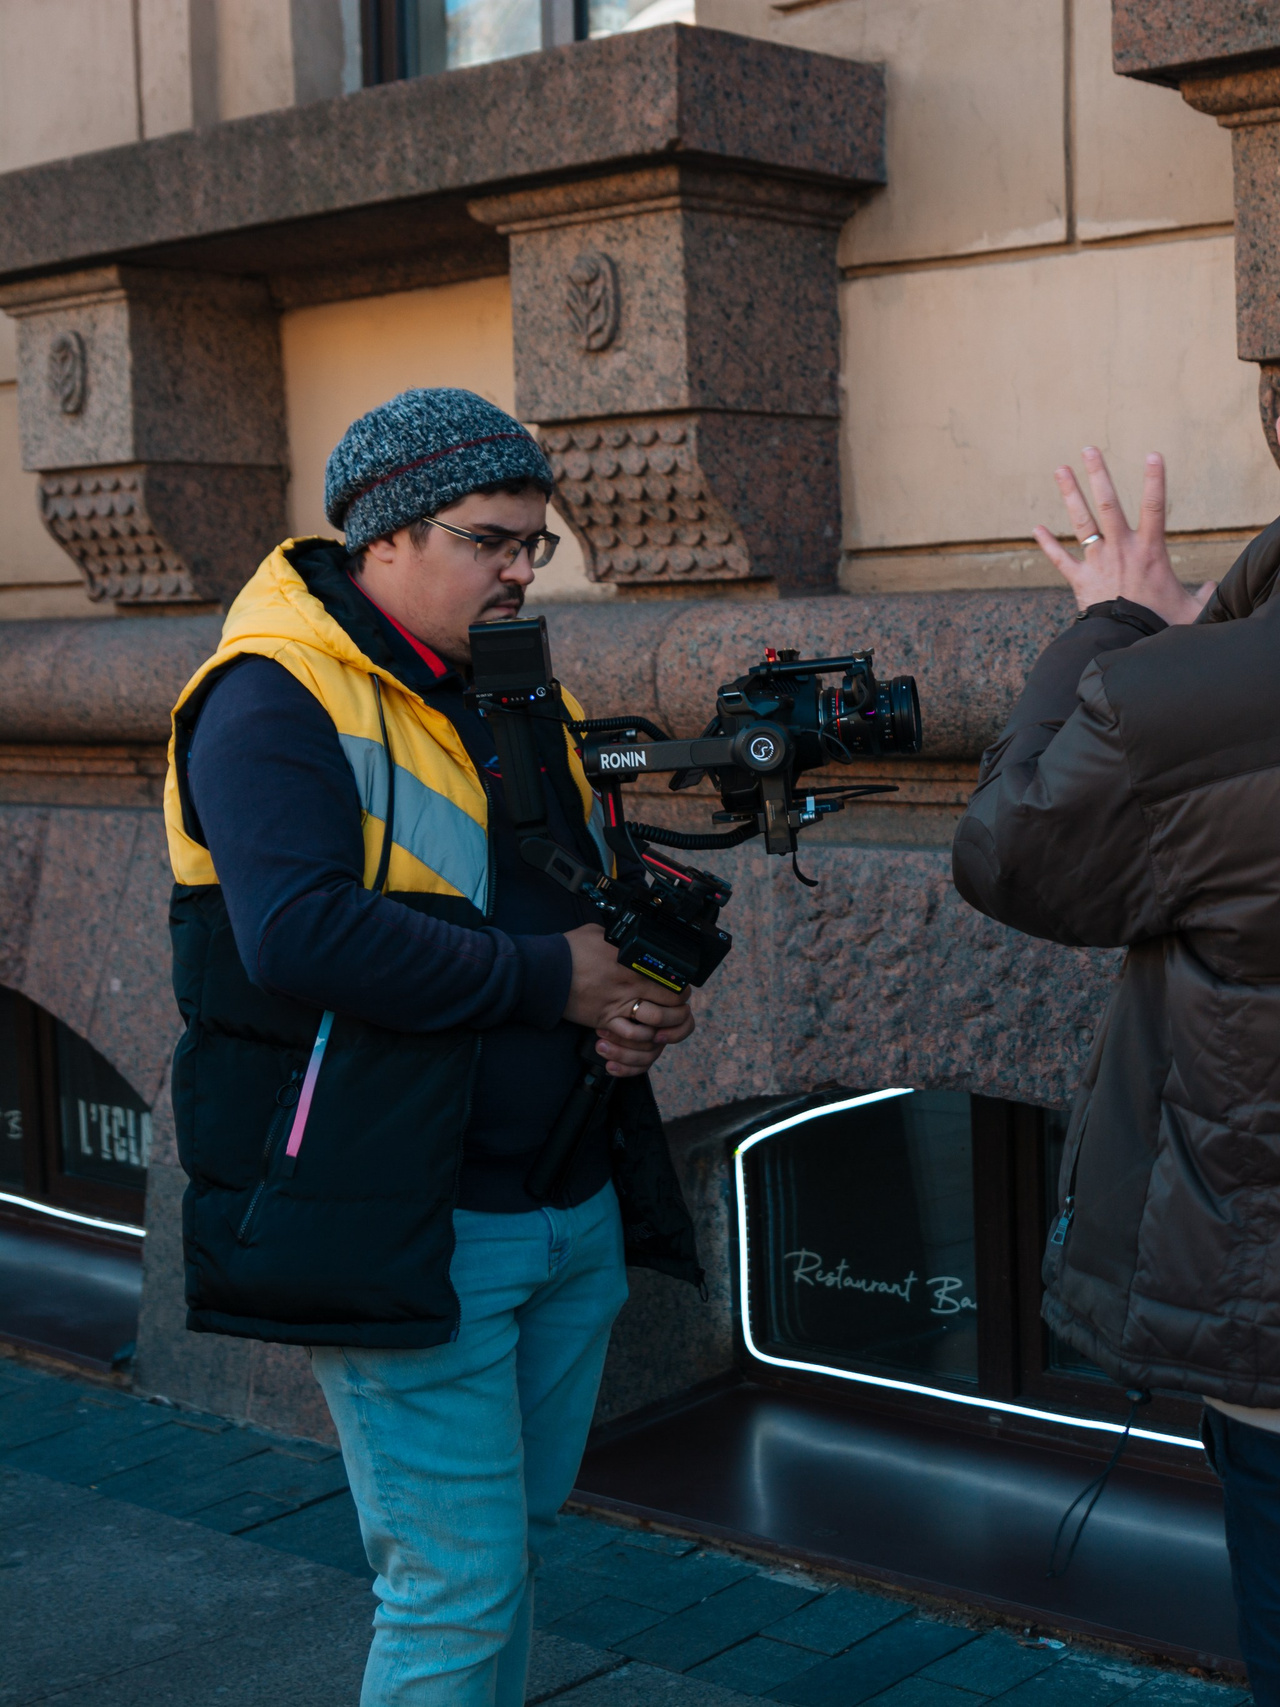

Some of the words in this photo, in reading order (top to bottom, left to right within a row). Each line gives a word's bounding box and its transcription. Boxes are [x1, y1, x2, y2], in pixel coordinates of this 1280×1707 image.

[600, 750, 647, 769] RONIN
[784, 1248, 918, 1303] Restaurant
[926, 1276, 978, 1315] Ba
